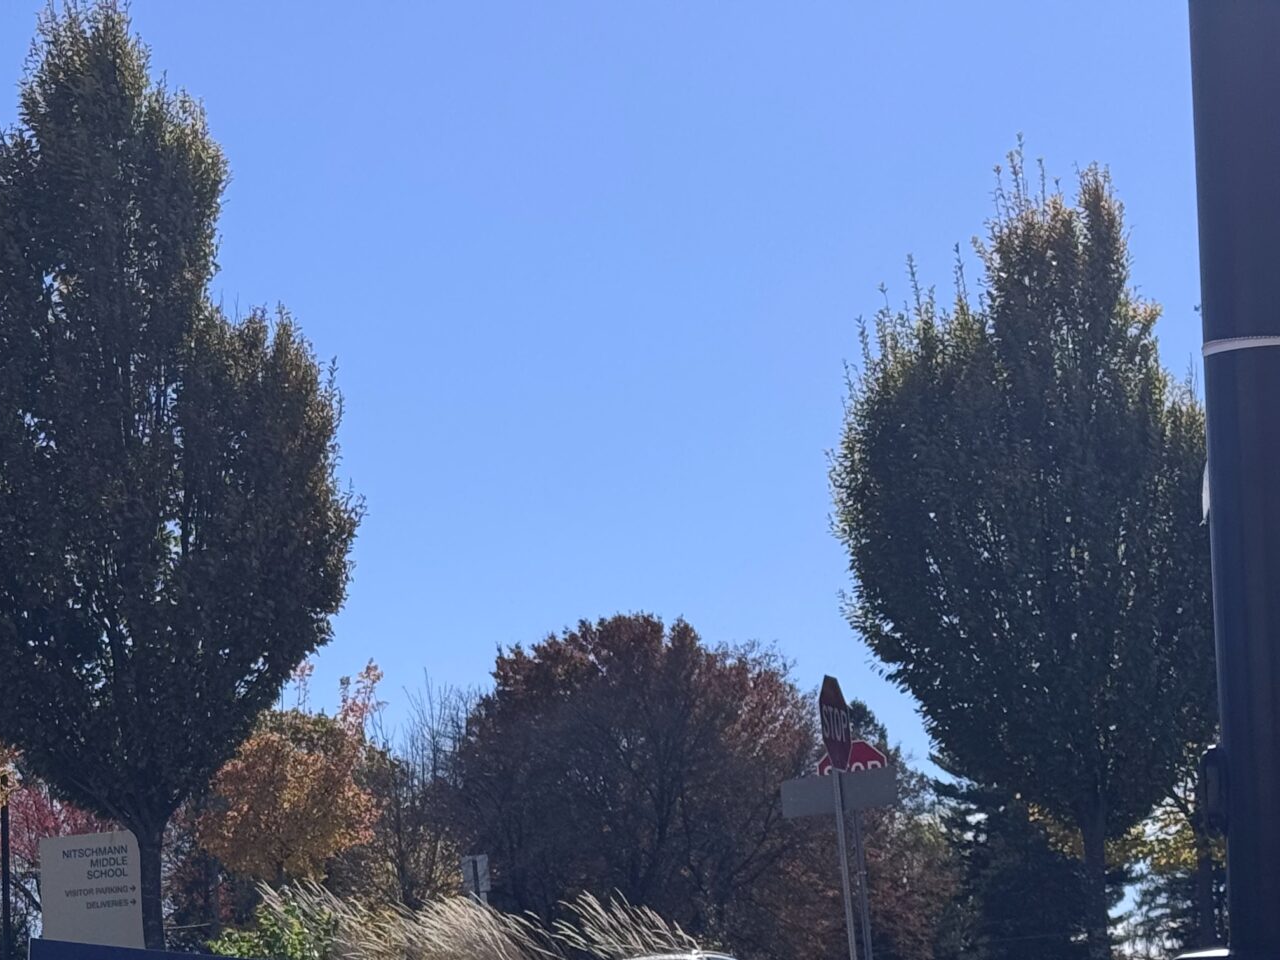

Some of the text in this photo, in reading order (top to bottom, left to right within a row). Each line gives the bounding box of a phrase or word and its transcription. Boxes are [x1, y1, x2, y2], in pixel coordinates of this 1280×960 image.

[822, 705, 848, 742] STOP
[62, 845, 128, 859] NITSCHMANN
[90, 856, 128, 868] MIDDLE
[87, 868, 128, 880] SCHOOL
[64, 885, 128, 897] VISITOR PARKING
[86, 899, 129, 909] DELIVERIES
